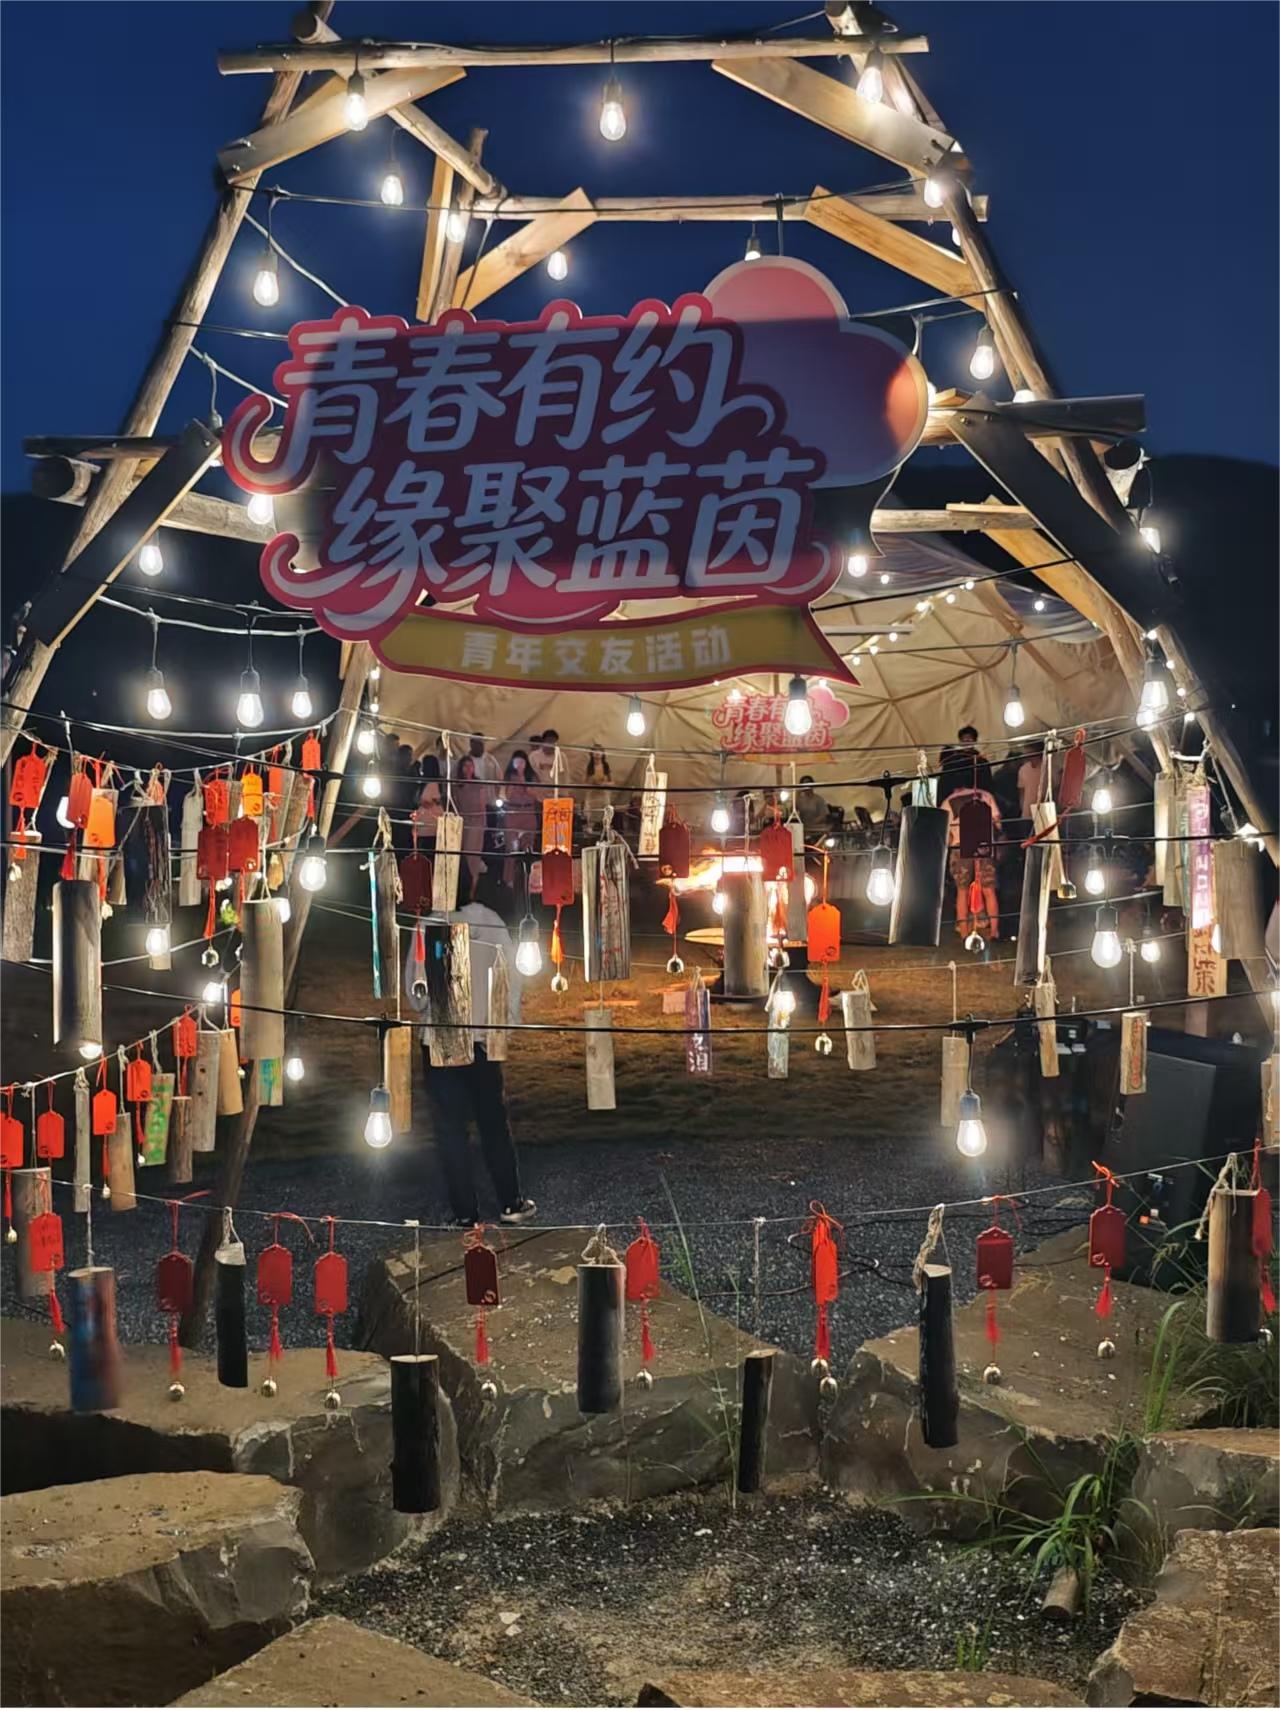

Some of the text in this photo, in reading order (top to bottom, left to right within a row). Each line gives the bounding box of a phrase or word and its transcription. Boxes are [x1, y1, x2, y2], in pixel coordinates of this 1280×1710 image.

[248, 302, 768, 470] 青春有约
[300, 448, 820, 597] 缘聚蓝茵
[460, 625, 733, 677] 青年交友活动
[721, 693, 814, 723] 青春有
